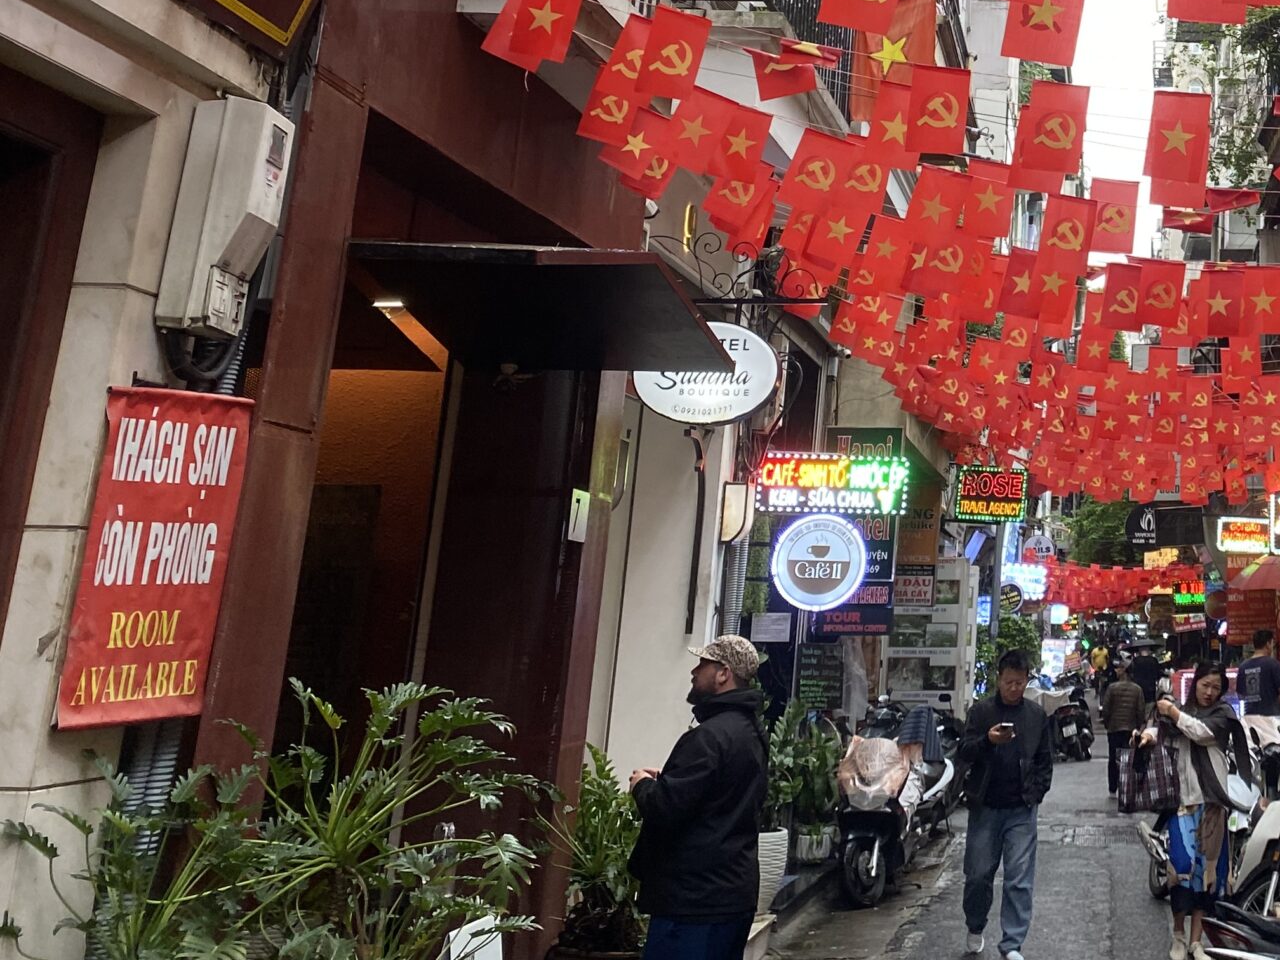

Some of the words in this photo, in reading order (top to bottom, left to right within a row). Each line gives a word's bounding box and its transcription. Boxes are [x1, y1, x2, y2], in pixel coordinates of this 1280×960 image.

[678, 388, 750, 397] BOUTIQUE
[188, 423, 237, 500] SẠN
[961, 472, 1023, 498] ROSE
[141, 506, 218, 586] PHÒNG
[106, 609, 182, 650] ROOM
[825, 611, 861, 622] TOUR
[69, 658, 199, 707] AVAILABLE
